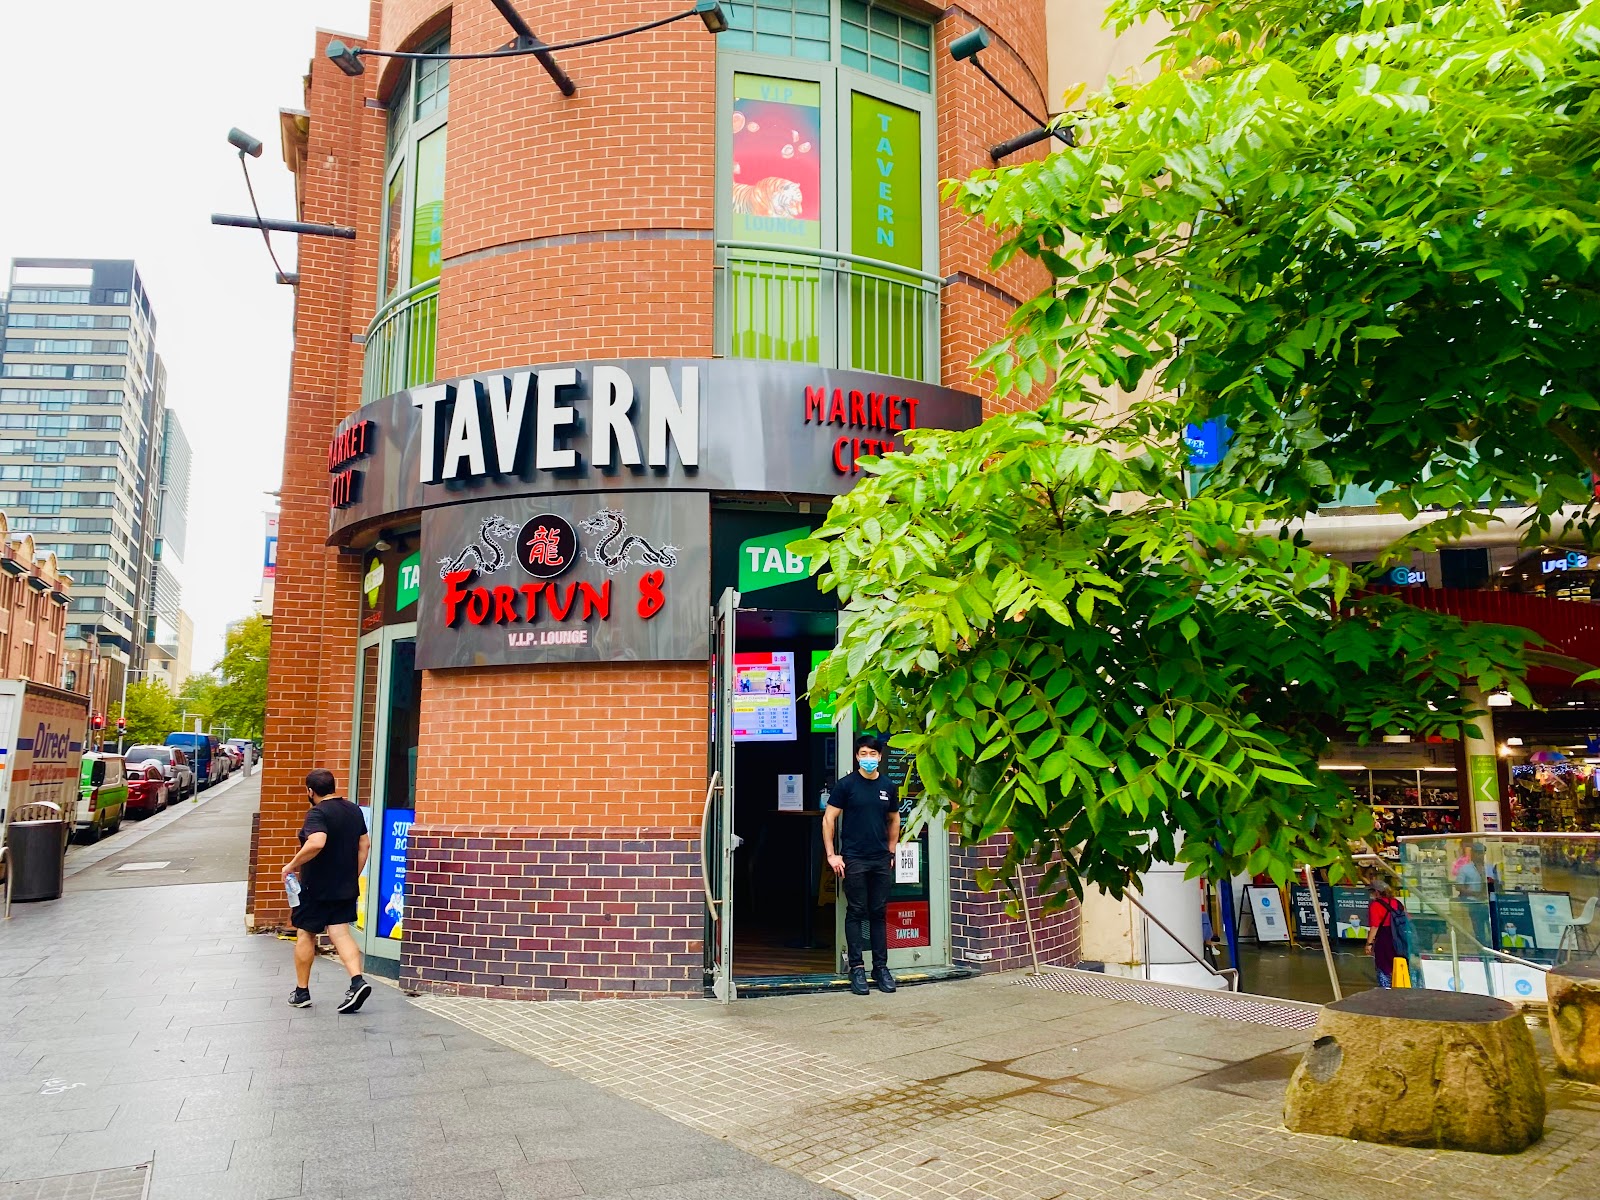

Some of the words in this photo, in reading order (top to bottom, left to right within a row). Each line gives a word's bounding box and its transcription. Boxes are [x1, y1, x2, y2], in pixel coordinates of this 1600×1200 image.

[876, 113, 894, 248] TAVERN
[412, 366, 699, 484] TAVERN
[804, 385, 920, 431] MARKET
[328, 419, 368, 473] MARKET
[331, 469, 353, 509] CITY
[526, 525, 564, 567] 龍
[745, 546, 804, 574] TAB
[401, 564, 420, 590] TA
[636, 569, 666, 620] 8
[540, 630, 588, 645] LOUNGE
[32, 721, 71, 759] Direct
[900, 858, 914, 869] OPEN
[898, 910, 916, 918] MARKET
[902, 918, 913, 926] CITY
[895, 928, 919, 939] TAVERN
